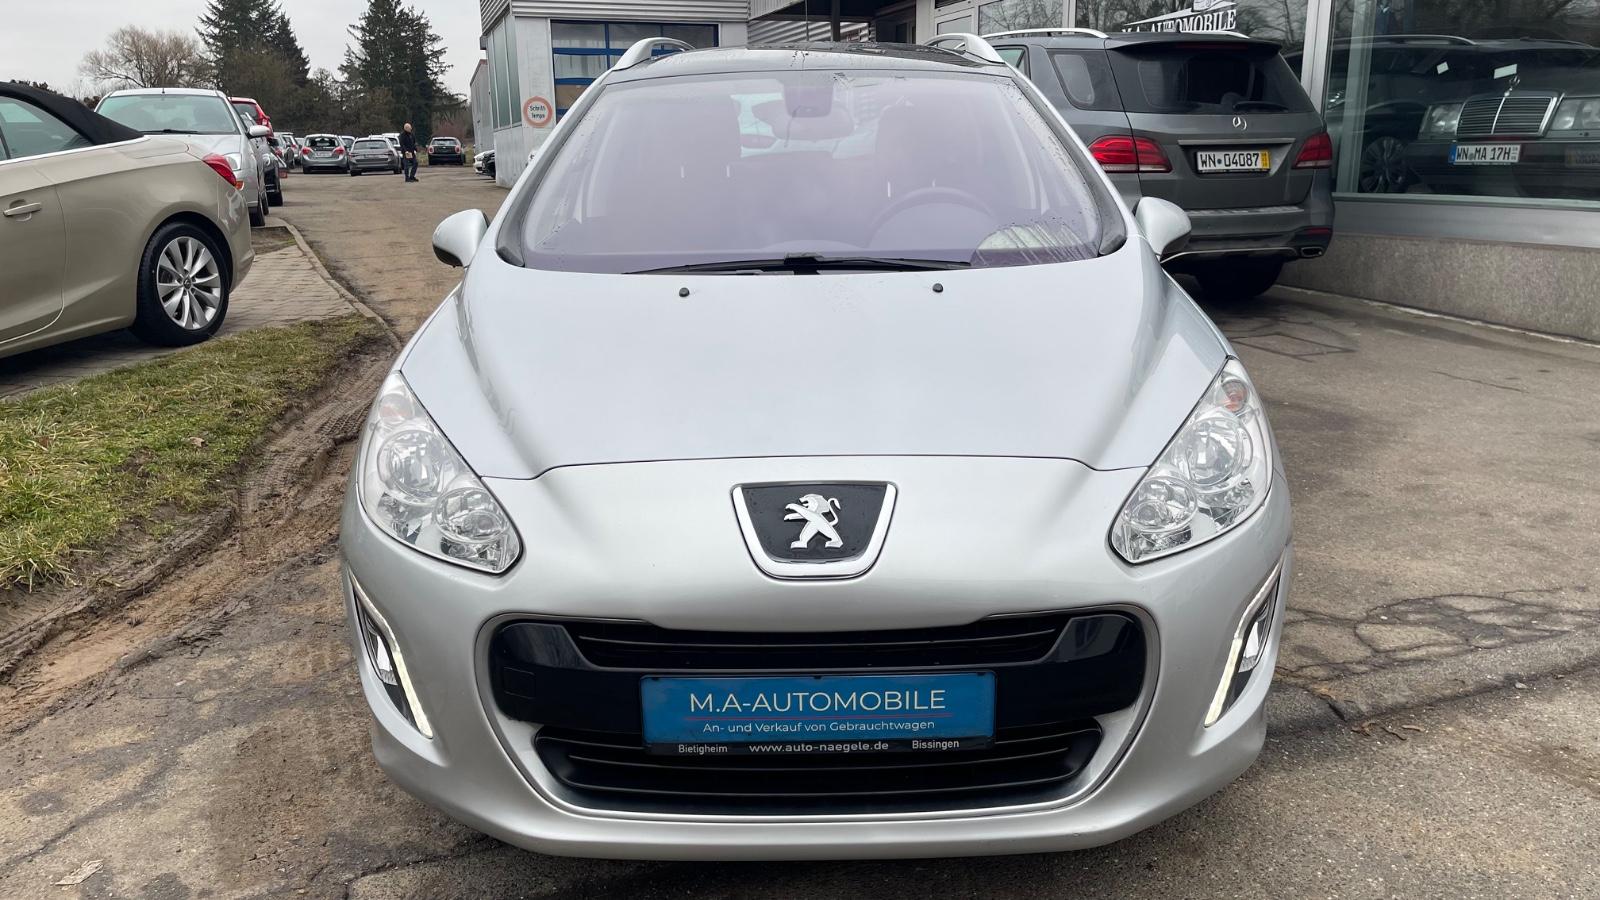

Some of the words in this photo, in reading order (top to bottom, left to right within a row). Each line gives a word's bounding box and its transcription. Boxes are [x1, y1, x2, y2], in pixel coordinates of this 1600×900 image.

[1200, 153, 1216, 168] WN
[1223, 152, 1259, 167] 04087
[1456, 147, 1469, 160] WN
[1474, 147, 1487, 160] MA
[1491, 147, 1512, 160] 17H
[690, 689, 946, 713] M.A-AUTOMOBILE
[703, 723, 725, 733] An-
[728, 723, 752, 732] und
[755, 722, 802, 733] Verkauf
[805, 723, 827, 732] von
[829, 720, 935, 732] Gebrauchtwagen
[678, 744, 728, 755] Bietigheim
[749, 741, 889, 753] www.auto-naegele.de
[912, 739, 960, 751] Bissingen
